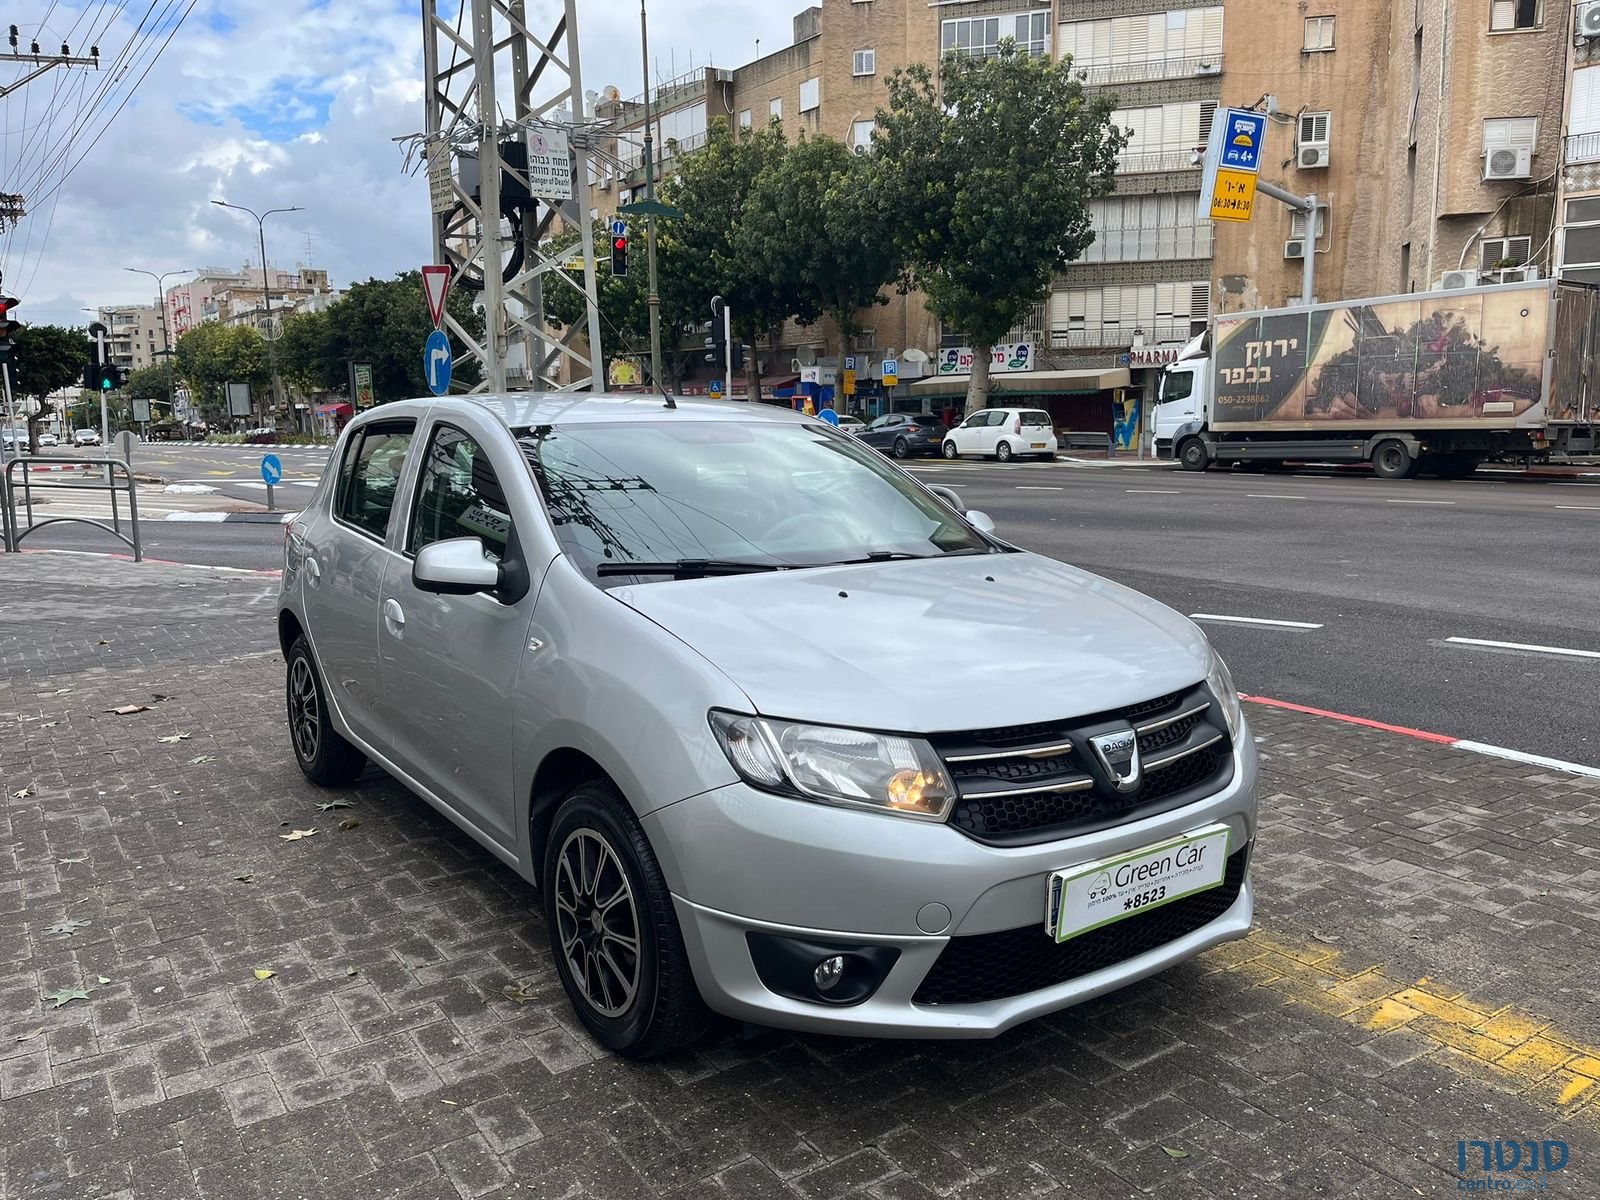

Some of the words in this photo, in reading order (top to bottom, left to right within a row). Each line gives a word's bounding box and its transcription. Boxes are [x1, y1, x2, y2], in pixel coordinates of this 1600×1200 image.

[530, 155, 550, 165] גבוה!
[552, 157, 568, 167] מתח
[1240, 150, 1253, 162] 4+
[530, 166, 549, 176] מוות!
[551, 167, 569, 177] סכנת
[1130, 349, 1179, 364] PHARMA
[1245, 338, 1298, 367] ירוק
[1219, 366, 1272, 385] בכפר
[1103, 738, 1135, 752] DACIA
[1115, 857, 1171, 887] Green
[1175, 845, 1207, 868] Car
